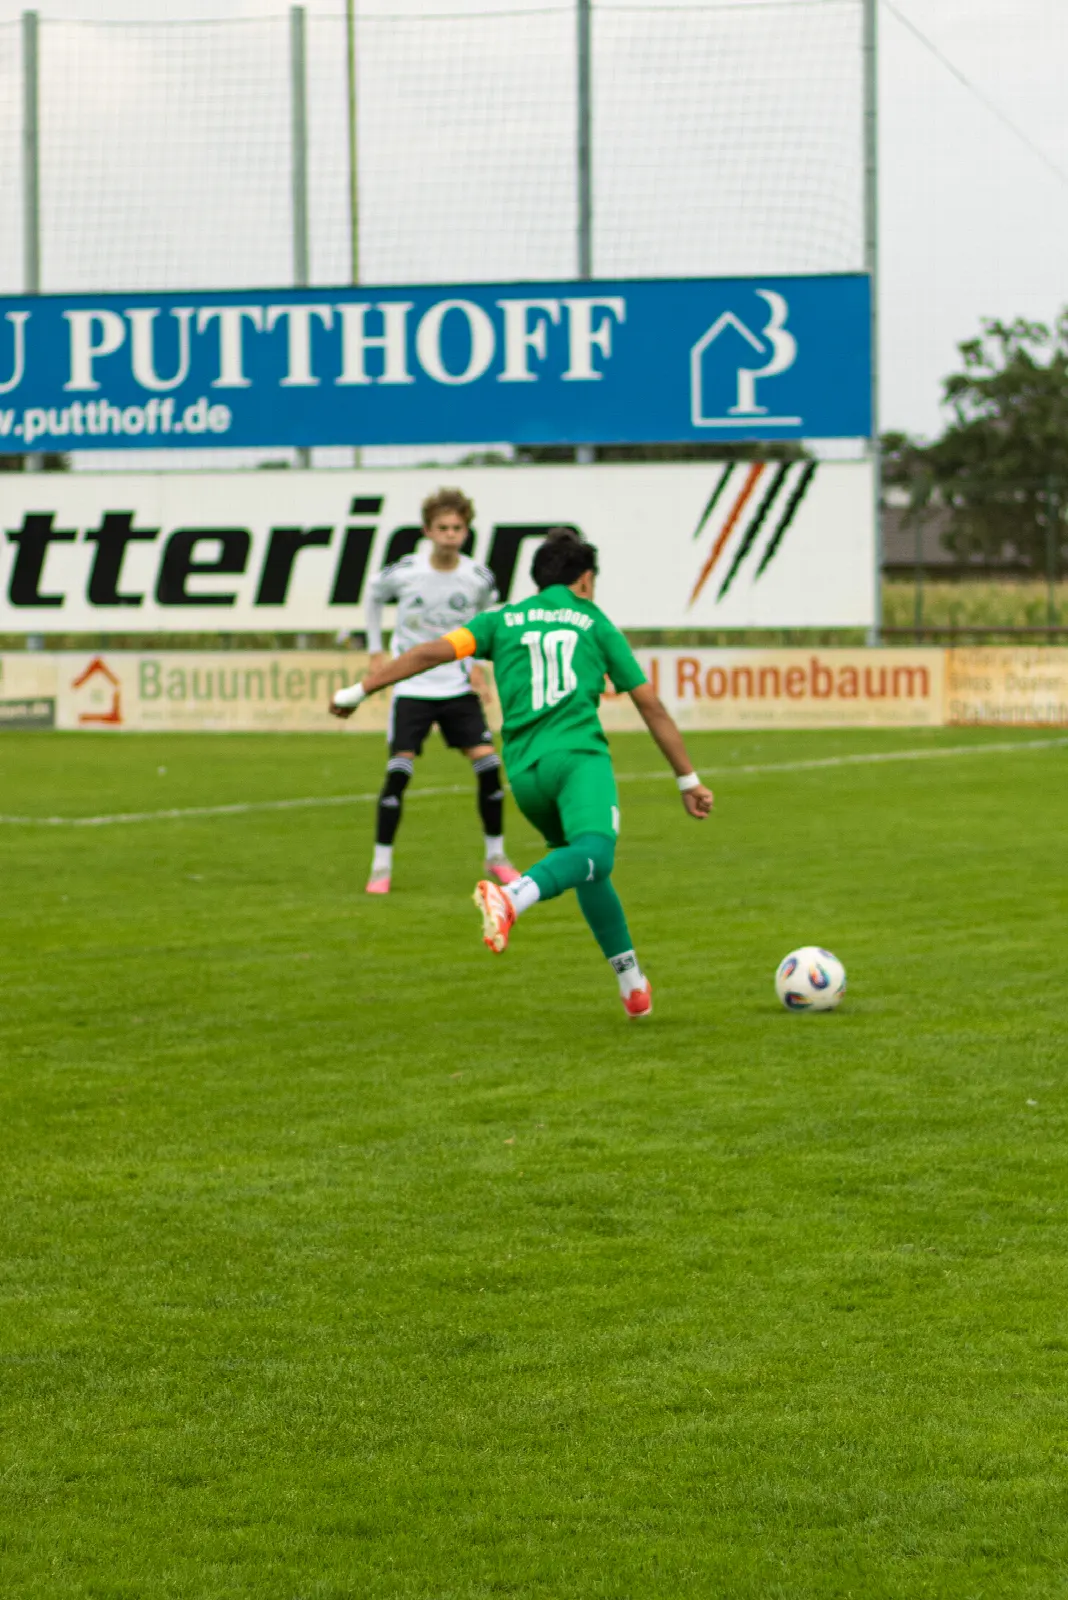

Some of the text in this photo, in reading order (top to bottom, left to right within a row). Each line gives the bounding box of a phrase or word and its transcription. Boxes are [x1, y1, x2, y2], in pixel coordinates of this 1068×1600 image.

[63, 297, 626, 391] PUTTHOFF
[520, 628, 578, 711] 10
[675, 655, 929, 699] Ronnebaum
